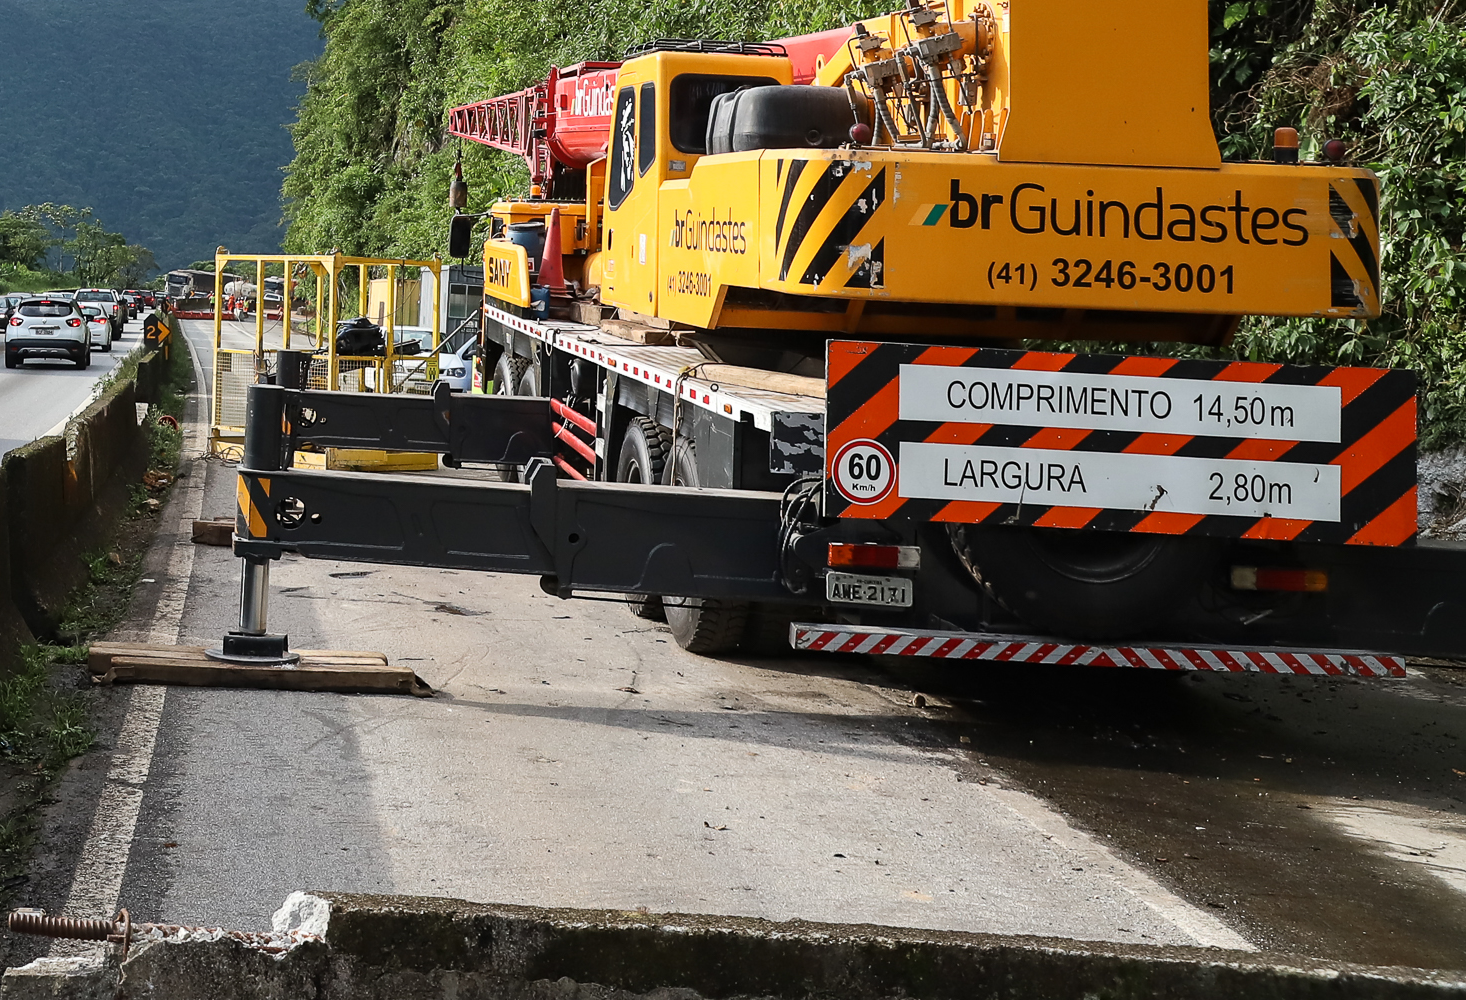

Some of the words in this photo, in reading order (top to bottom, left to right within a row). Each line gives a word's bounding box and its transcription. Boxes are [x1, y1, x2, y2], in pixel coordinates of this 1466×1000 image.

[489, 257, 512, 289] SANY
[667, 275, 677, 297] (41)
[678, 271, 712, 297] 3246-3001
[986, 261, 1038, 291] (41)
[1050, 257, 1235, 295] 3246-3001
[146, 325, 156, 339] 2
[947, 380, 1172, 419] COMPRIMENTO
[848, 453, 881, 481] 60
[943, 458, 1087, 493] LARGURA
[1209, 472, 1292, 504] 2,80m
[852, 483, 876, 492] Km/h
